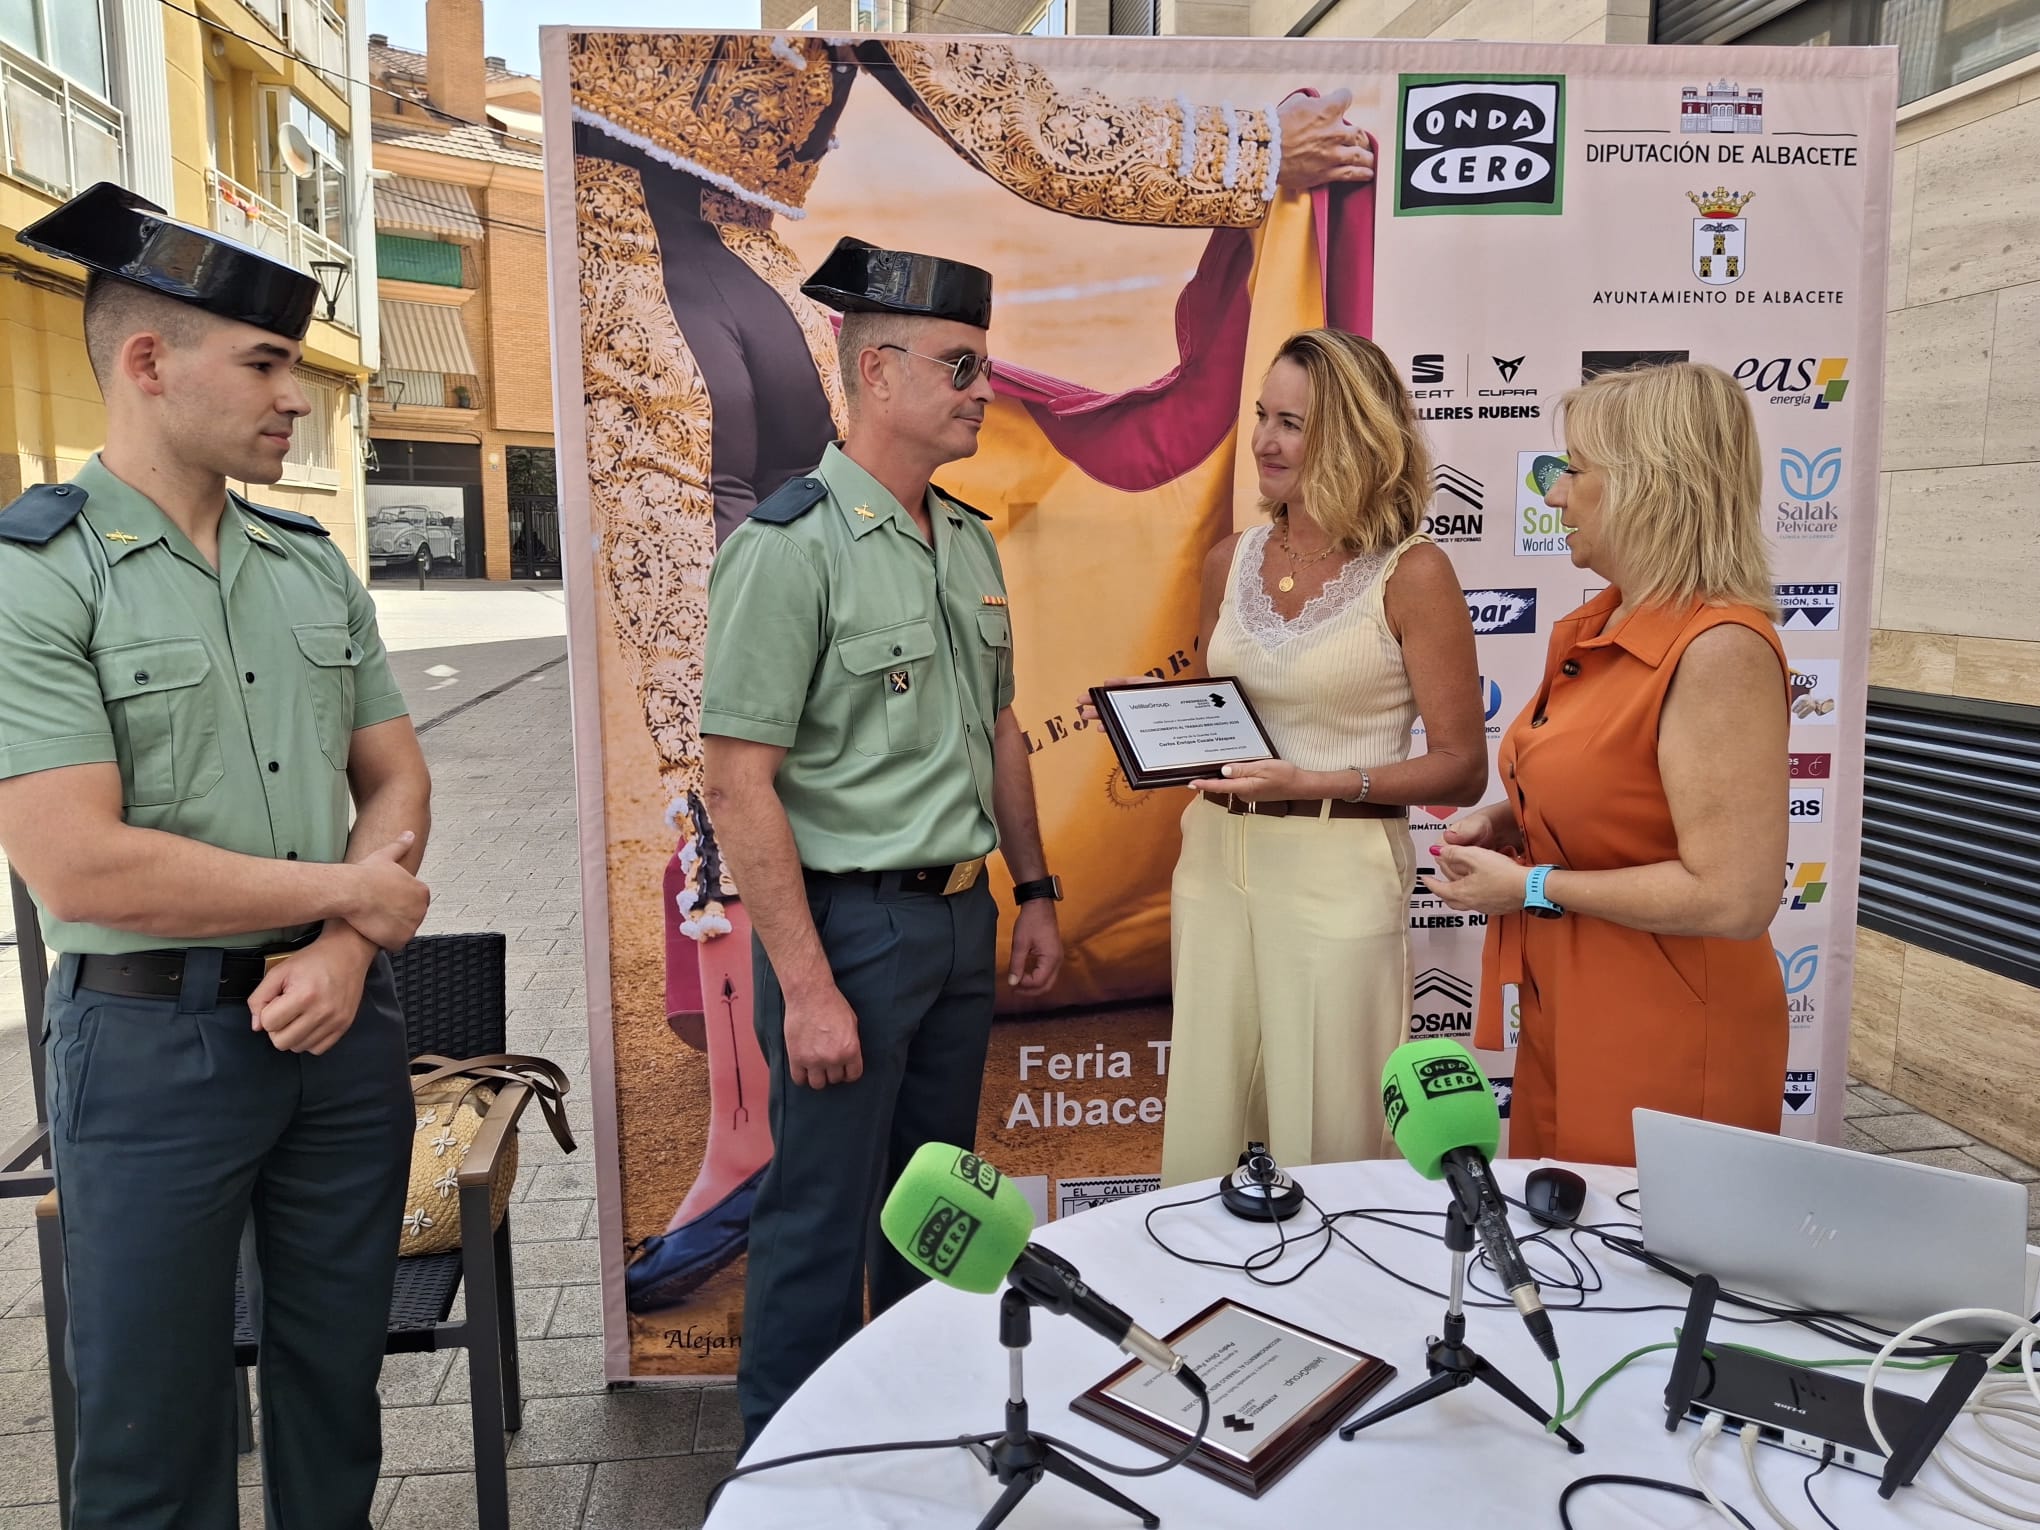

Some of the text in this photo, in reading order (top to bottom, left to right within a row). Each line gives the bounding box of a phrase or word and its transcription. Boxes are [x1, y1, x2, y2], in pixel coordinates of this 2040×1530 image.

[1425, 108, 1535, 136] ONDA
[1586, 140, 1858, 167] DIPUTACIÓN DE ALBACETE
[1430, 156, 1534, 184] CERO
[1593, 291, 1844, 304] AYUNTAMIENTO DE ALBACETE
[1733, 358, 1816, 392] eas
[1478, 389, 1538, 397] CUPRA
[1770, 393, 1811, 406] energía
[1414, 406, 1540, 420] LLERES RUBENS
[1777, 501, 1838, 521] Salak
[1424, 514, 1483, 535] OSAN
[1523, 506, 1573, 535] Sol
[1776, 521, 1838, 533] Pelvicare
[1522, 538, 1554, 552] World
[1779, 585, 1836, 595] LETAJE
[1778, 597, 1809, 606] ISIÓN,
[1788, 757, 1799, 765] es
[1790, 799, 1820, 816] as
[1410, 900, 1443, 908] EAT
[1410, 914, 1488, 928] LLERES RU
[1410, 1012, 1472, 1033] OSAN
[1019, 1041, 1172, 1081] Feria T
[1426, 1062, 1466, 1074] ONDA
[1434, 1075, 1473, 1088] CERO
[1786, 1073, 1813, 1081] AJE
[1006, 1092, 1163, 1129] Albace
[1073, 1187, 1088, 1197] EL
[918, 1210, 951, 1255] ONDA
[937, 1223, 967, 1263] CERO
[664, 1325, 742, 1358] Alejan
